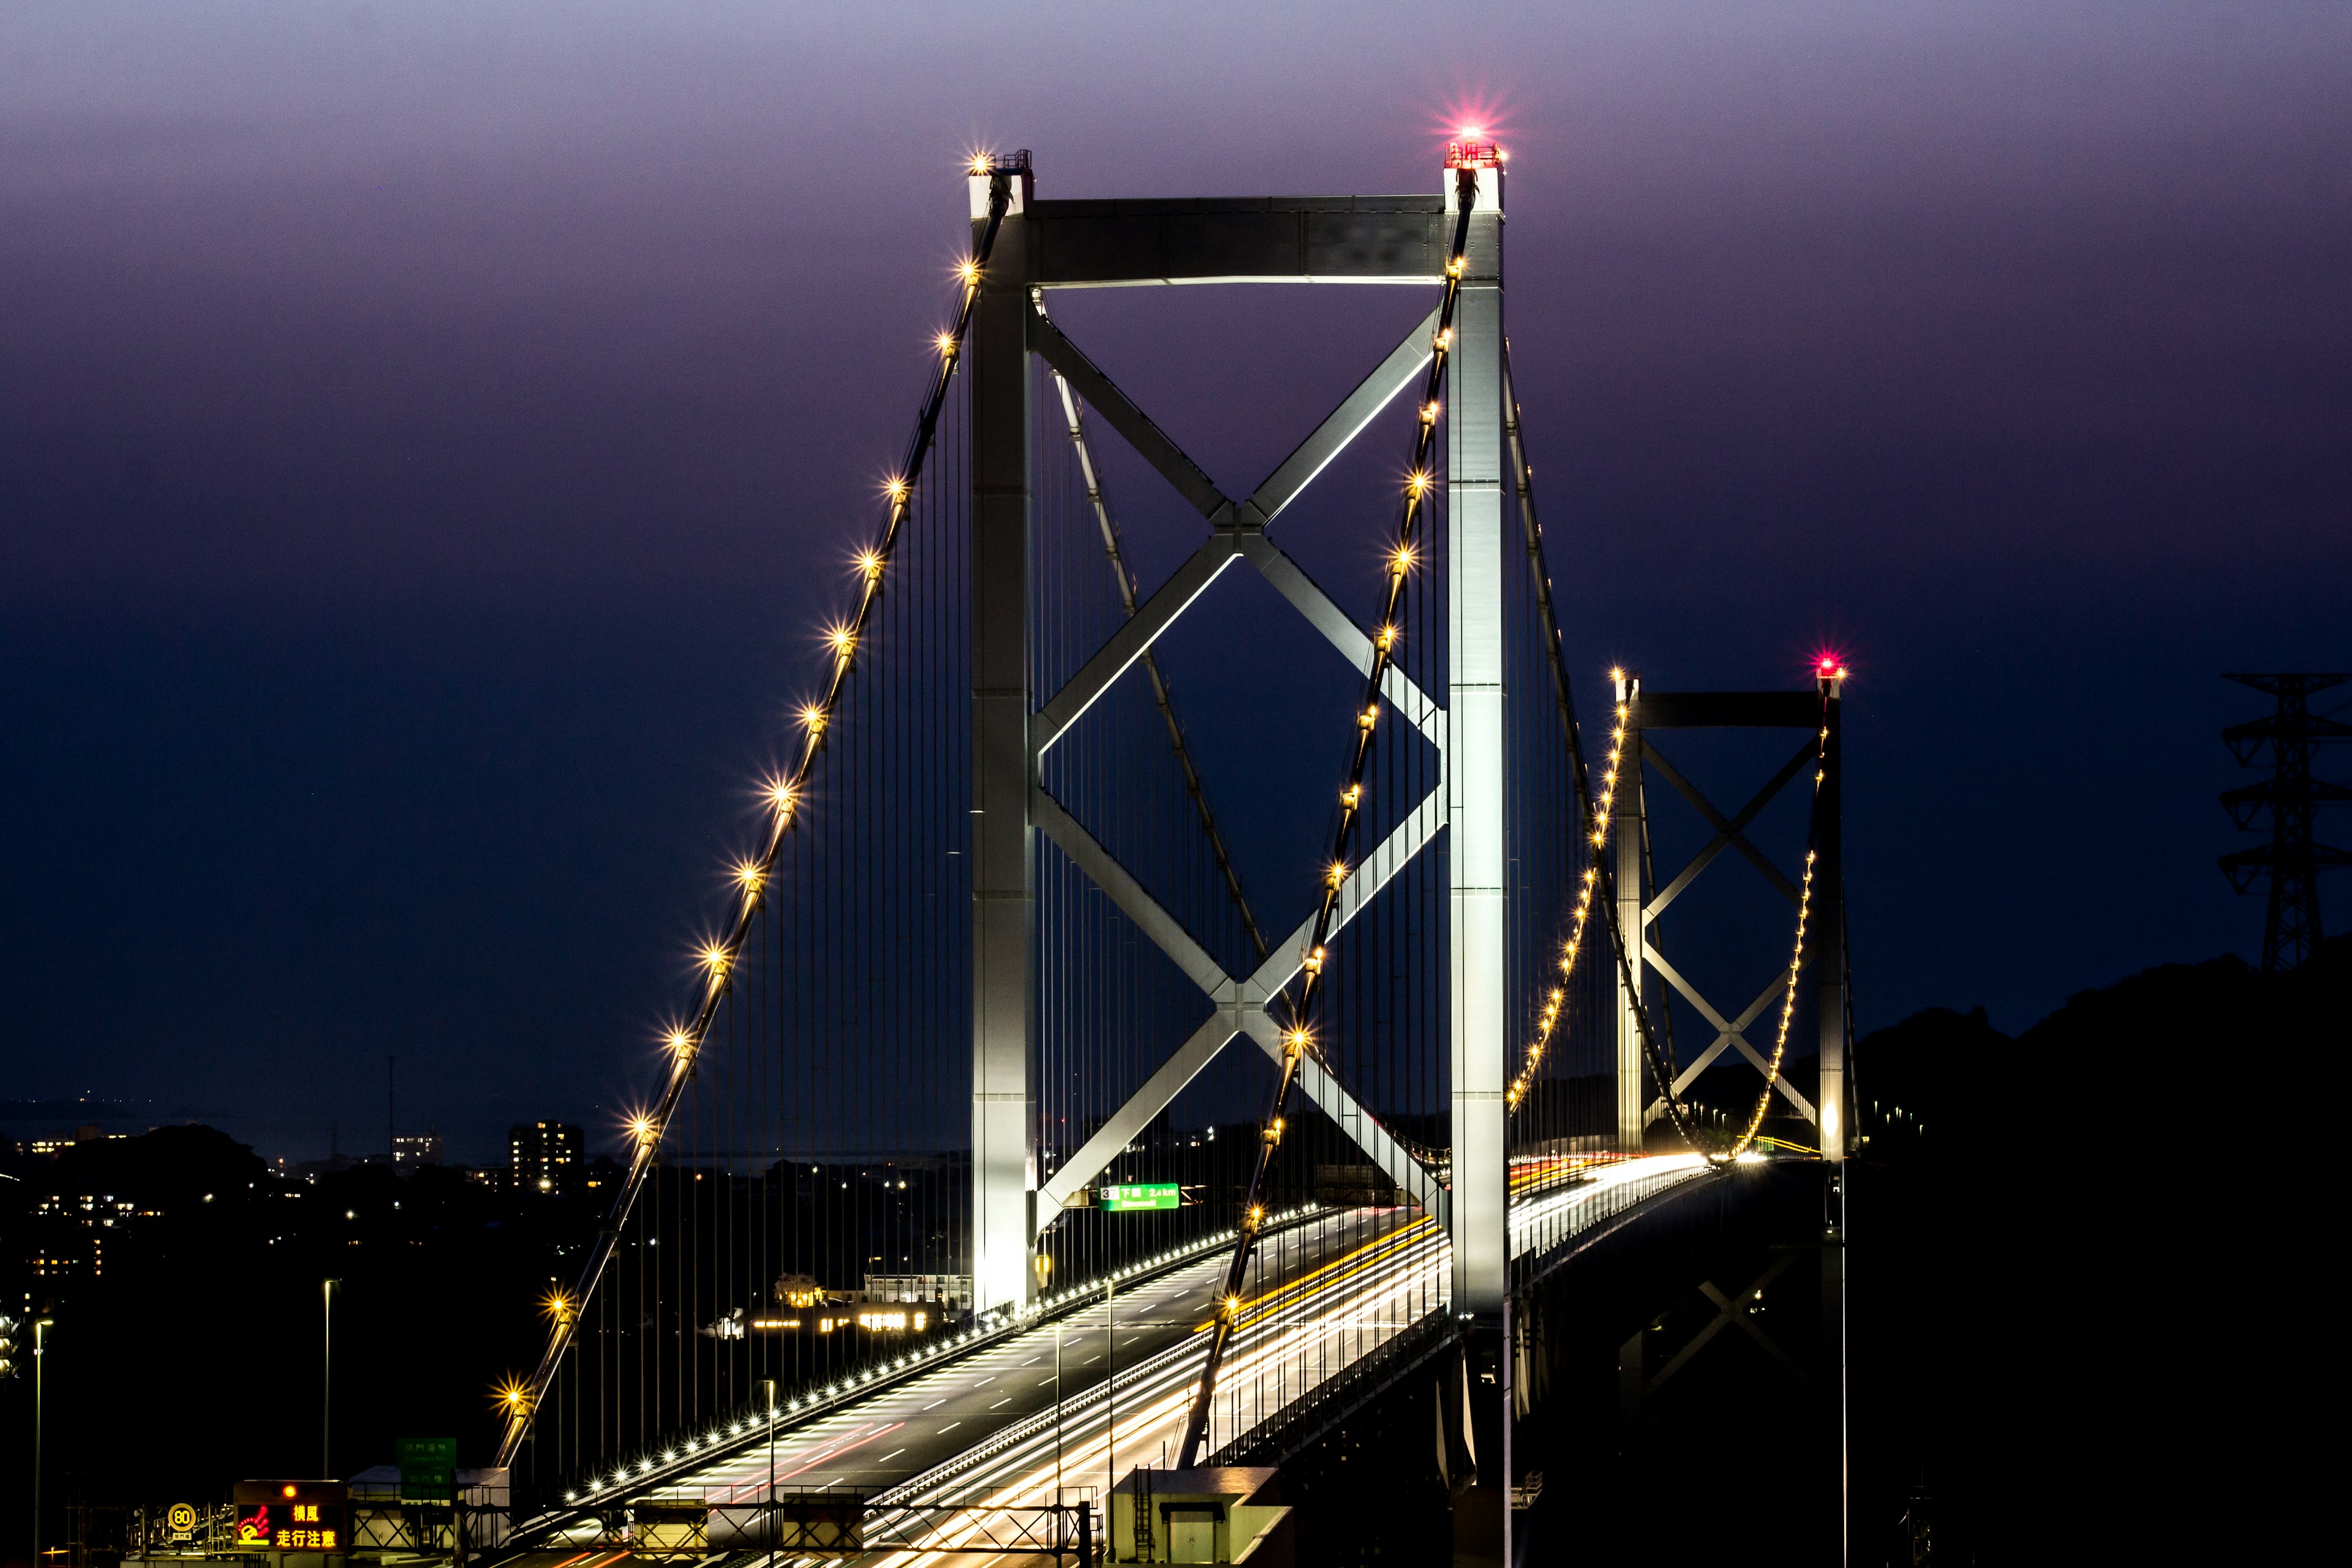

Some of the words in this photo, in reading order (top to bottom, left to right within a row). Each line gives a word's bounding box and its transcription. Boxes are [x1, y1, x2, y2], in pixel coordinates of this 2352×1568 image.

[1102, 1189, 1116, 1199] 37
[175, 1510, 190, 1524] 80
[294, 1505, 318, 1521] 横風
[277, 1530, 335, 1547] 走行注意
